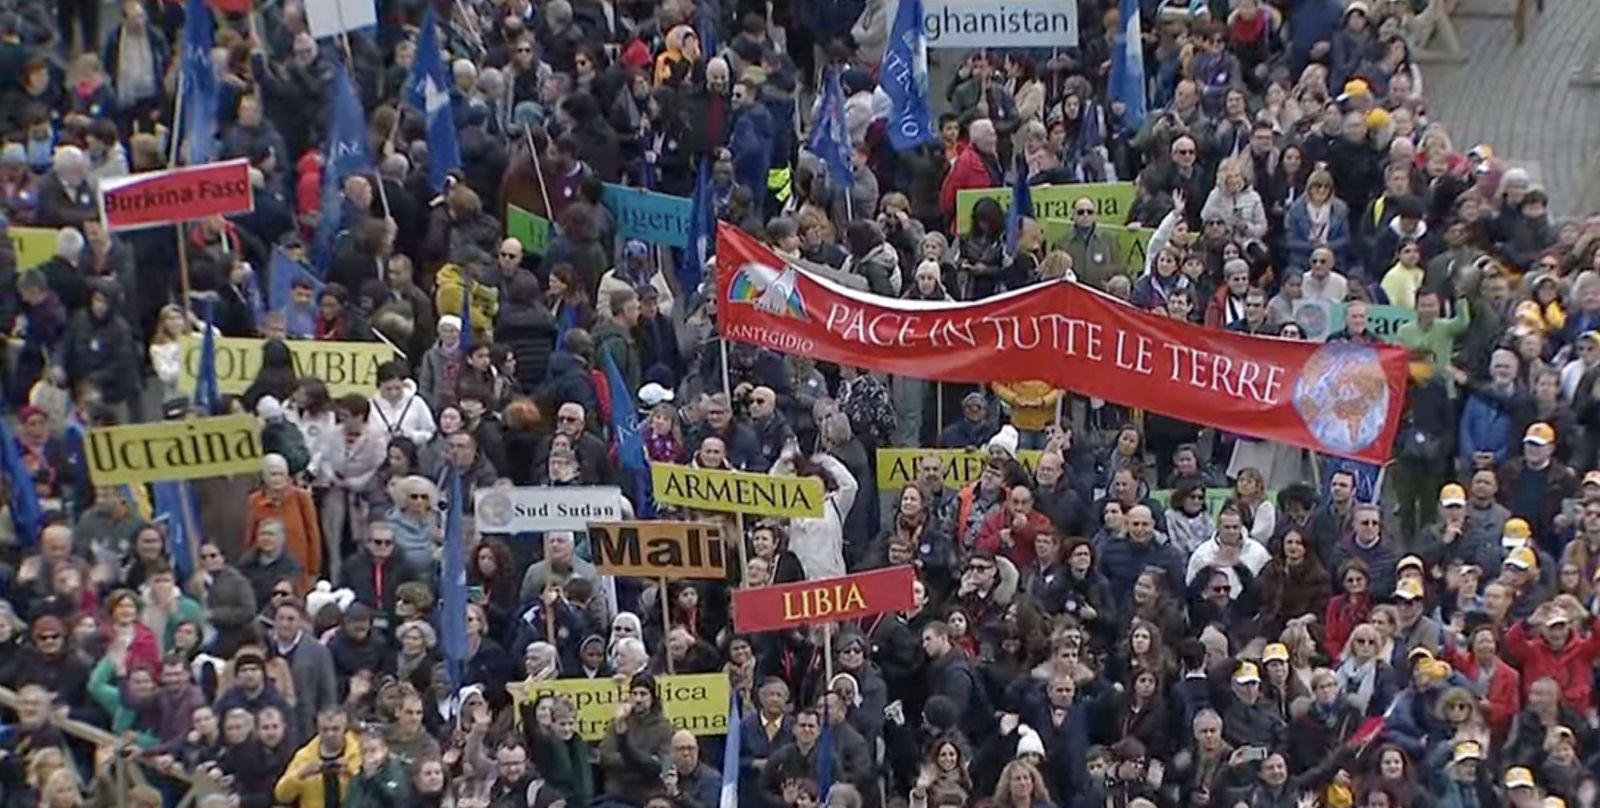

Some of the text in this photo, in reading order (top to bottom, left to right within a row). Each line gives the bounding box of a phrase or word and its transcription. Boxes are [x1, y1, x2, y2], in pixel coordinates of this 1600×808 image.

[924, 6, 1068, 40] ghanistan
[104, 178, 247, 212] Burkina Faso
[184, 346, 379, 385] COLMBIA
[826, 302, 1285, 405] PACE IN TUTTE LE TERRE
[90, 425, 260, 472] Ucraina
[514, 503, 614, 517] Sud Sudan
[664, 472, 812, 510] ARMENIA
[588, 527, 724, 568] Mali
[783, 582, 867, 620] LIBIA
